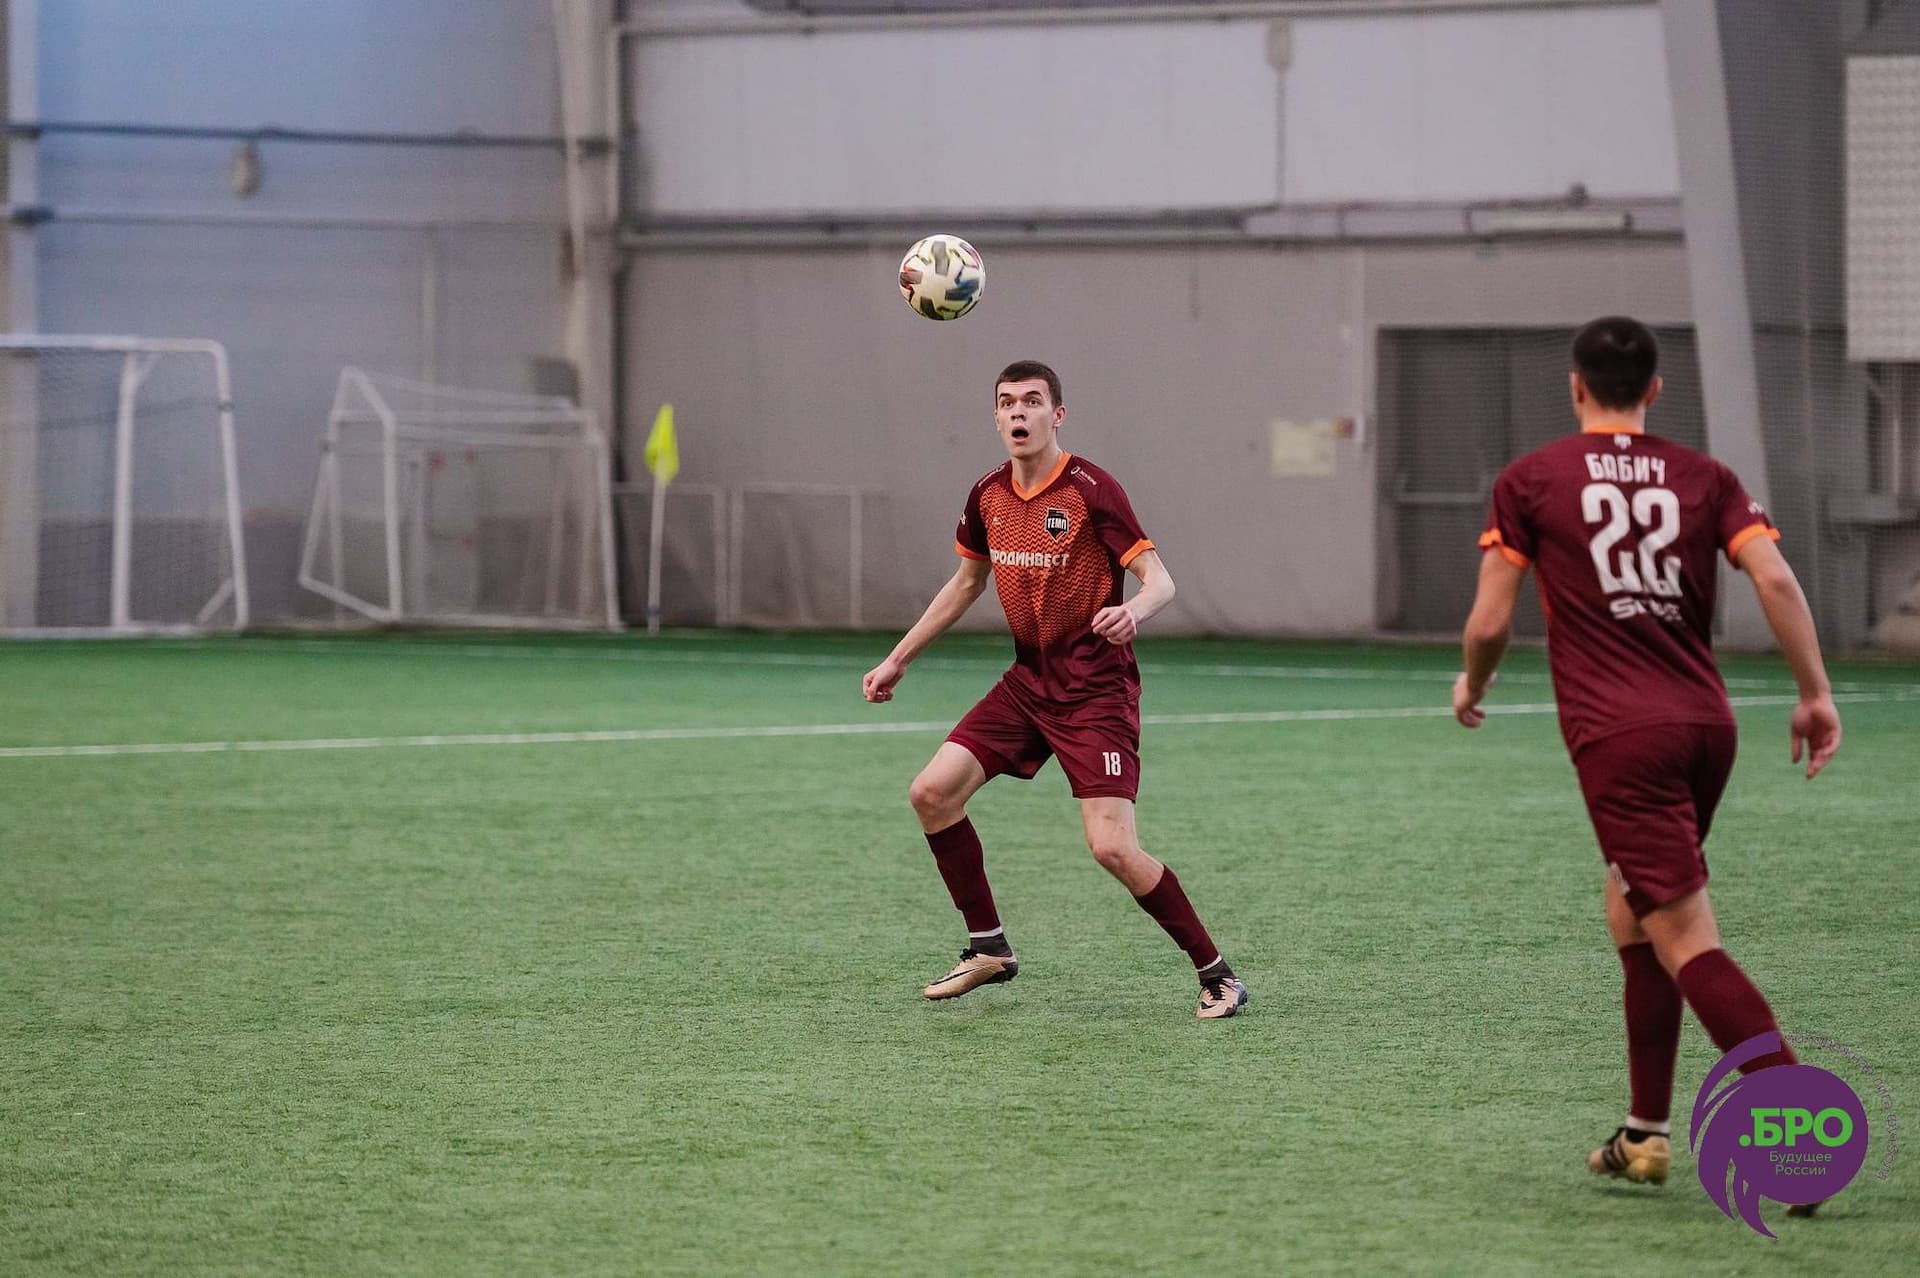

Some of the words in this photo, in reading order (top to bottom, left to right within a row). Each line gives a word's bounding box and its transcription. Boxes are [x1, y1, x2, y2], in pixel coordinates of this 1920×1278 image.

[1584, 452, 1666, 485] БАБИЧ
[1047, 517, 1067, 530] ТЕМП
[1581, 483, 1684, 597] 22
[1102, 751, 1122, 776] 18
